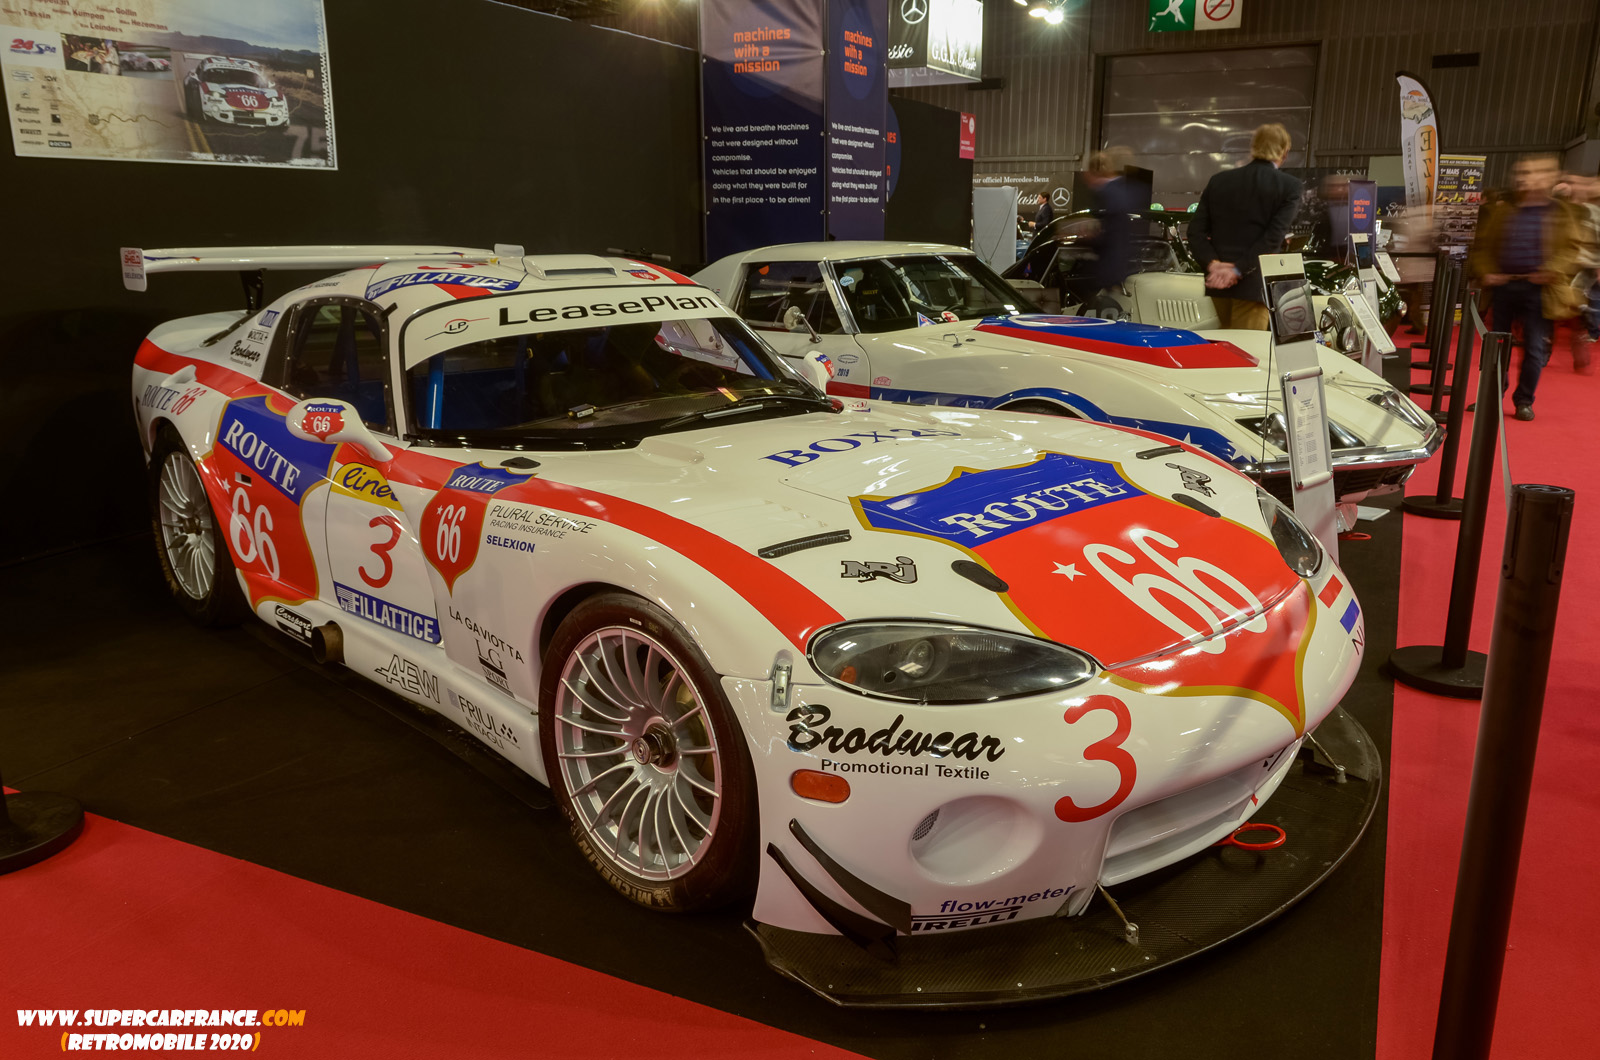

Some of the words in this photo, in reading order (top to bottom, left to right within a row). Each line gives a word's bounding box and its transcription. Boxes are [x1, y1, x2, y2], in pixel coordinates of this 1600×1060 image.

[734, 27, 791, 42] machines
[844, 30, 872, 48] machines
[734, 44, 758, 58] with
[762, 46, 770, 56] a
[844, 45, 857, 59] with
[858, 50, 862, 60] a
[734, 60, 780, 74] mission
[844, 60, 867, 76] mission
[750, 124, 776, 132] breathe
[777, 123, 809, 131] Machines
[742, 139, 773, 148] designed
[712, 154, 752, 163] compromise.
[789, 167, 817, 176] enjoyed
[1004, 175, 1049, 183] Mercedes-Benz
[713, 182, 731, 191] doing
[749, 182, 763, 190] they
[798, 182, 807, 190] for
[732, 196, 744, 204] first
[386, 270, 515, 290] FILLATTICE
[449, 321, 467, 331] LP
[499, 295, 718, 326] LeasePlan
[141, 384, 180, 410] ROUTE
[313, 415, 330, 432] 66
[223, 418, 300, 495] ROUTE
[450, 474, 504, 493] ROUTE
[939, 477, 1127, 538] ROUTE
[490, 505, 533, 523] PLURAL
[535, 513, 597, 534] SERVICE
[490, 519, 518, 530] RACING
[519, 524, 567, 539] INSURANCE
[229, 486, 280, 581] 66
[436, 504, 467, 563] 66
[486, 534, 535, 553] SELEXION
[358, 515, 401, 588] 3
[1083, 528, 1267, 654] 66
[276, 607, 311, 630] Carsport
[352, 593, 434, 643] FILLATTICE
[449, 606, 463, 625] LA
[464, 617, 525, 664] GAVIOTTA
[474, 637, 503, 670] LG
[482, 665, 509, 690] SPORT
[458, 695, 501, 738] FRIUL
[786, 704, 1005, 763] Brodwear
[821, 759, 928, 776] Promotional
[935, 765, 990, 780] Textile
[1055, 694, 1137, 823] 3
[579, 839, 652, 906] MICHELIN
[940, 885, 1076, 913] flow-meter
